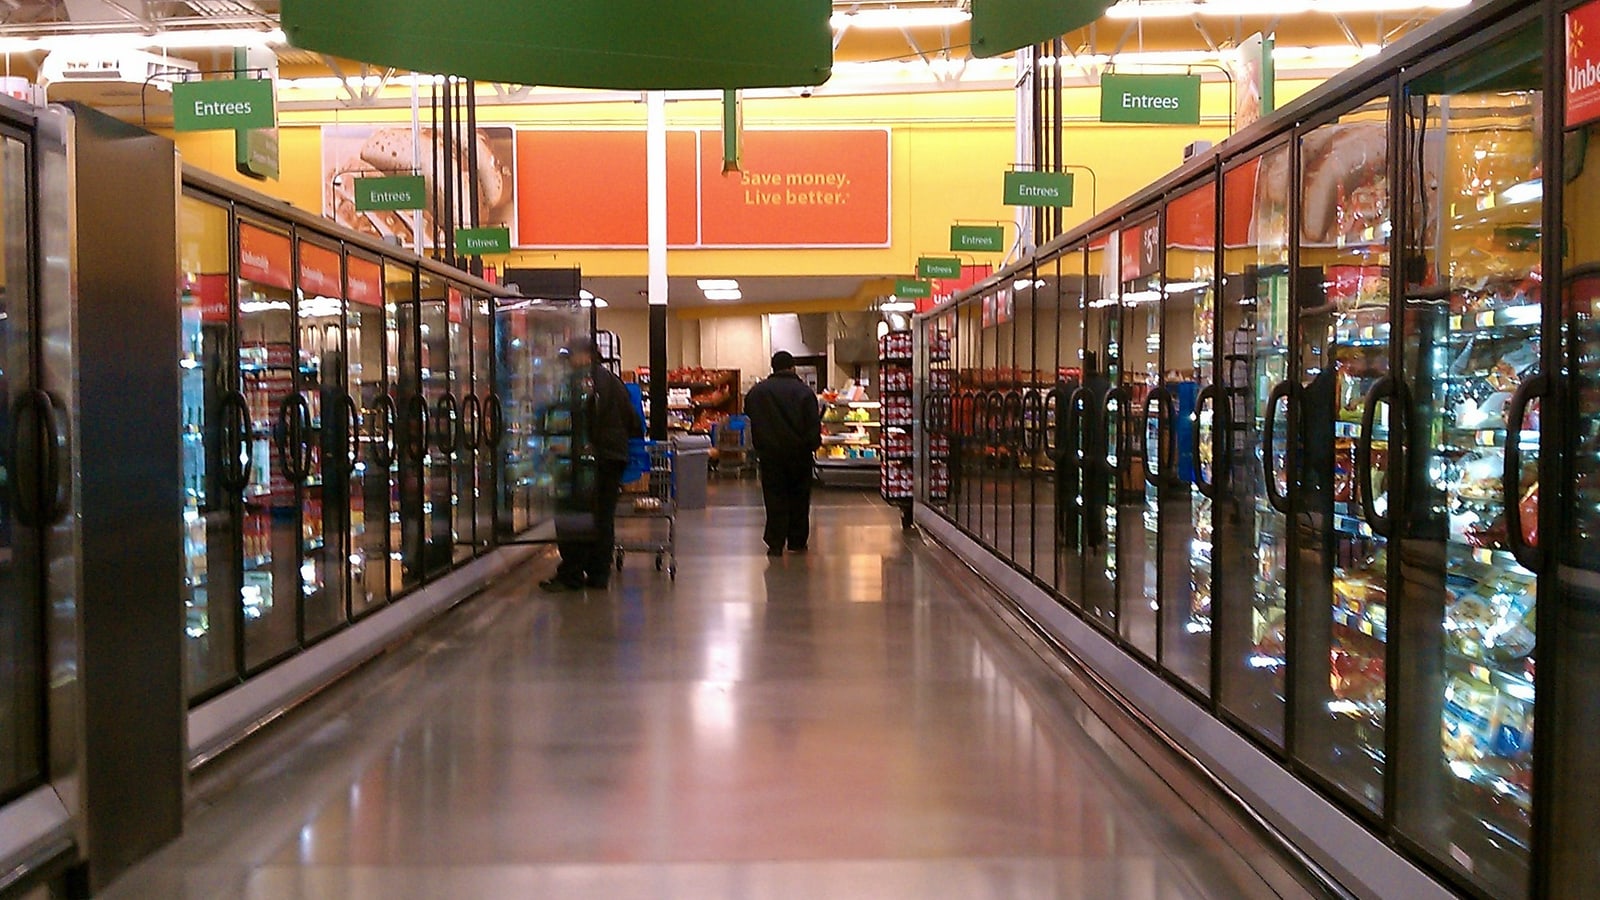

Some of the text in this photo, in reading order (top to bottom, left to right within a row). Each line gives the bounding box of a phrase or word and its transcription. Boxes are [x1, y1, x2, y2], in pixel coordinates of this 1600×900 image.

[1122, 92, 1179, 109] Entrees
[194, 100, 252, 116] Entrees
[741, 170, 851, 189] Save money.
[1019, 184, 1059, 197] Entrees
[370, 191, 411, 203] Entrees
[745, 189, 847, 205] Live better.
[467, 238, 499, 249] Entrees
[961, 235, 993, 245] Entrees
[926, 265, 953, 274] Entrees
[902, 286, 924, 294] Entrees
